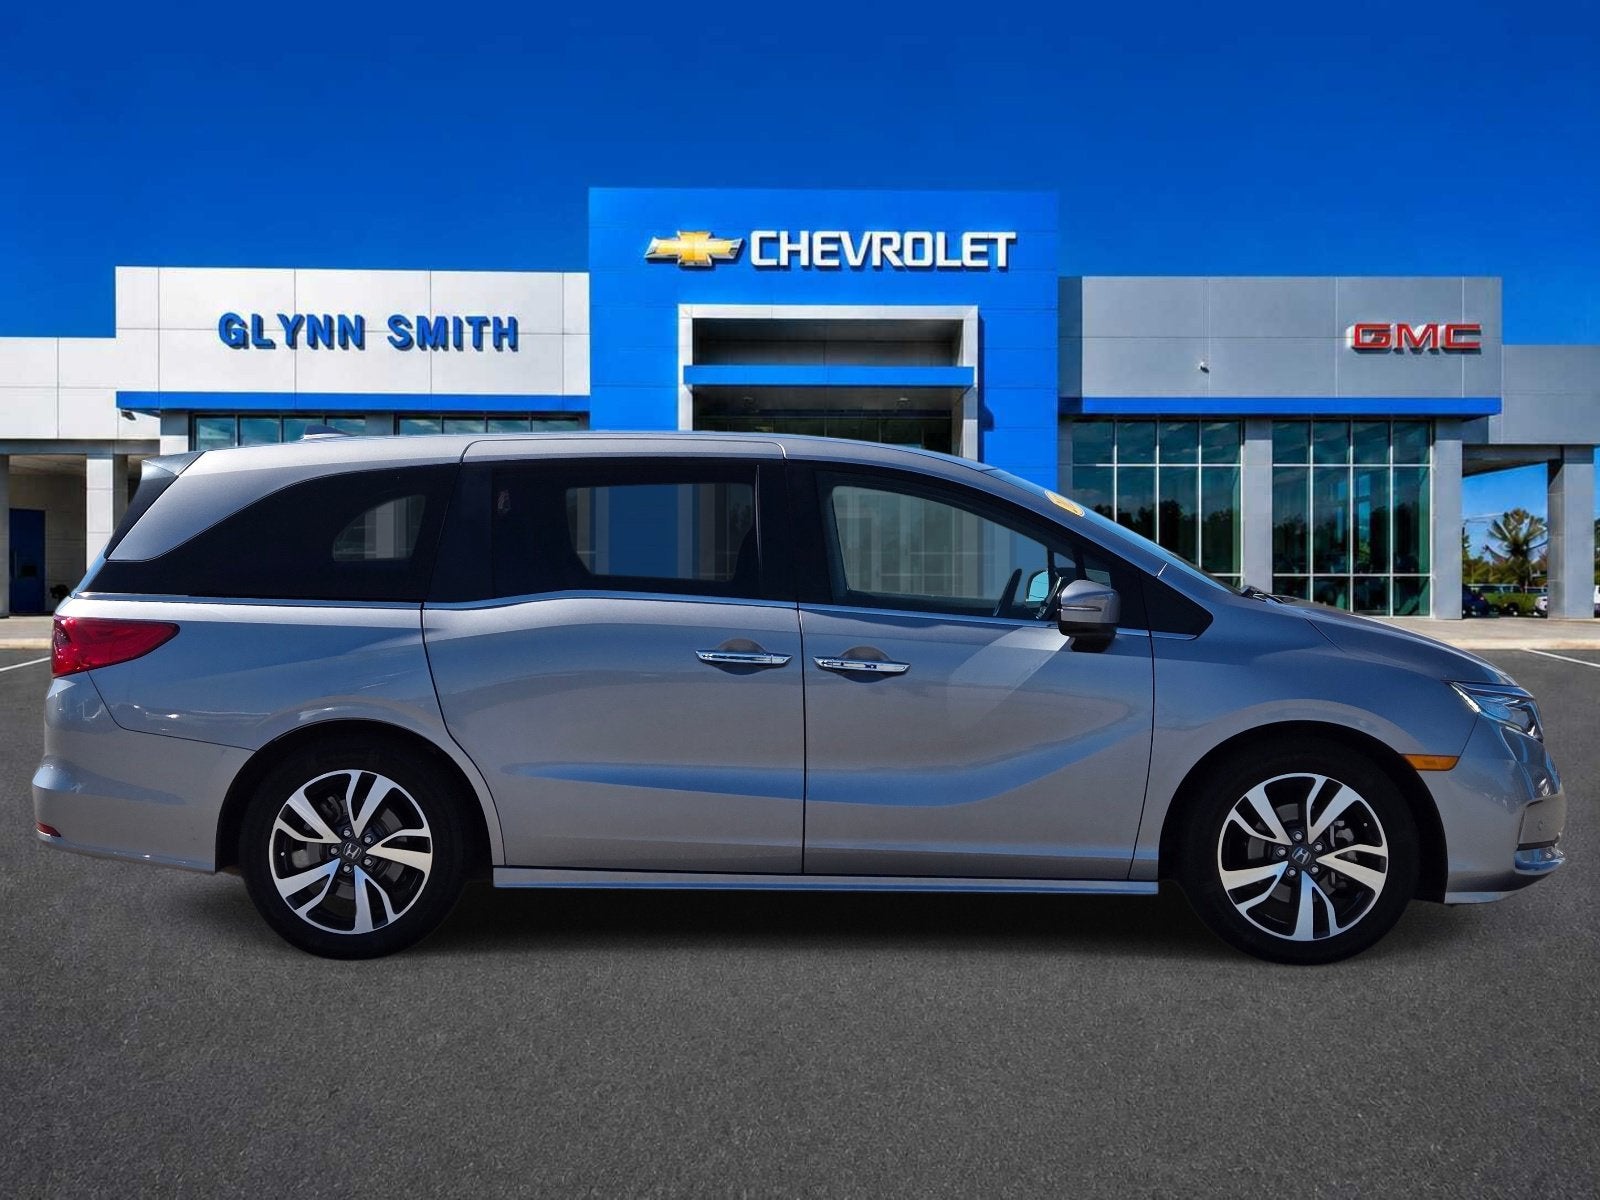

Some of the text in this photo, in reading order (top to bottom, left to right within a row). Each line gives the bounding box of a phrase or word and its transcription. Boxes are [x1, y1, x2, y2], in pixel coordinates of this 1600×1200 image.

[750, 230, 1017, 270] CHEVROLET
[218, 312, 519, 351] GLYNN SMITH
[1352, 323, 1482, 353] GMC
